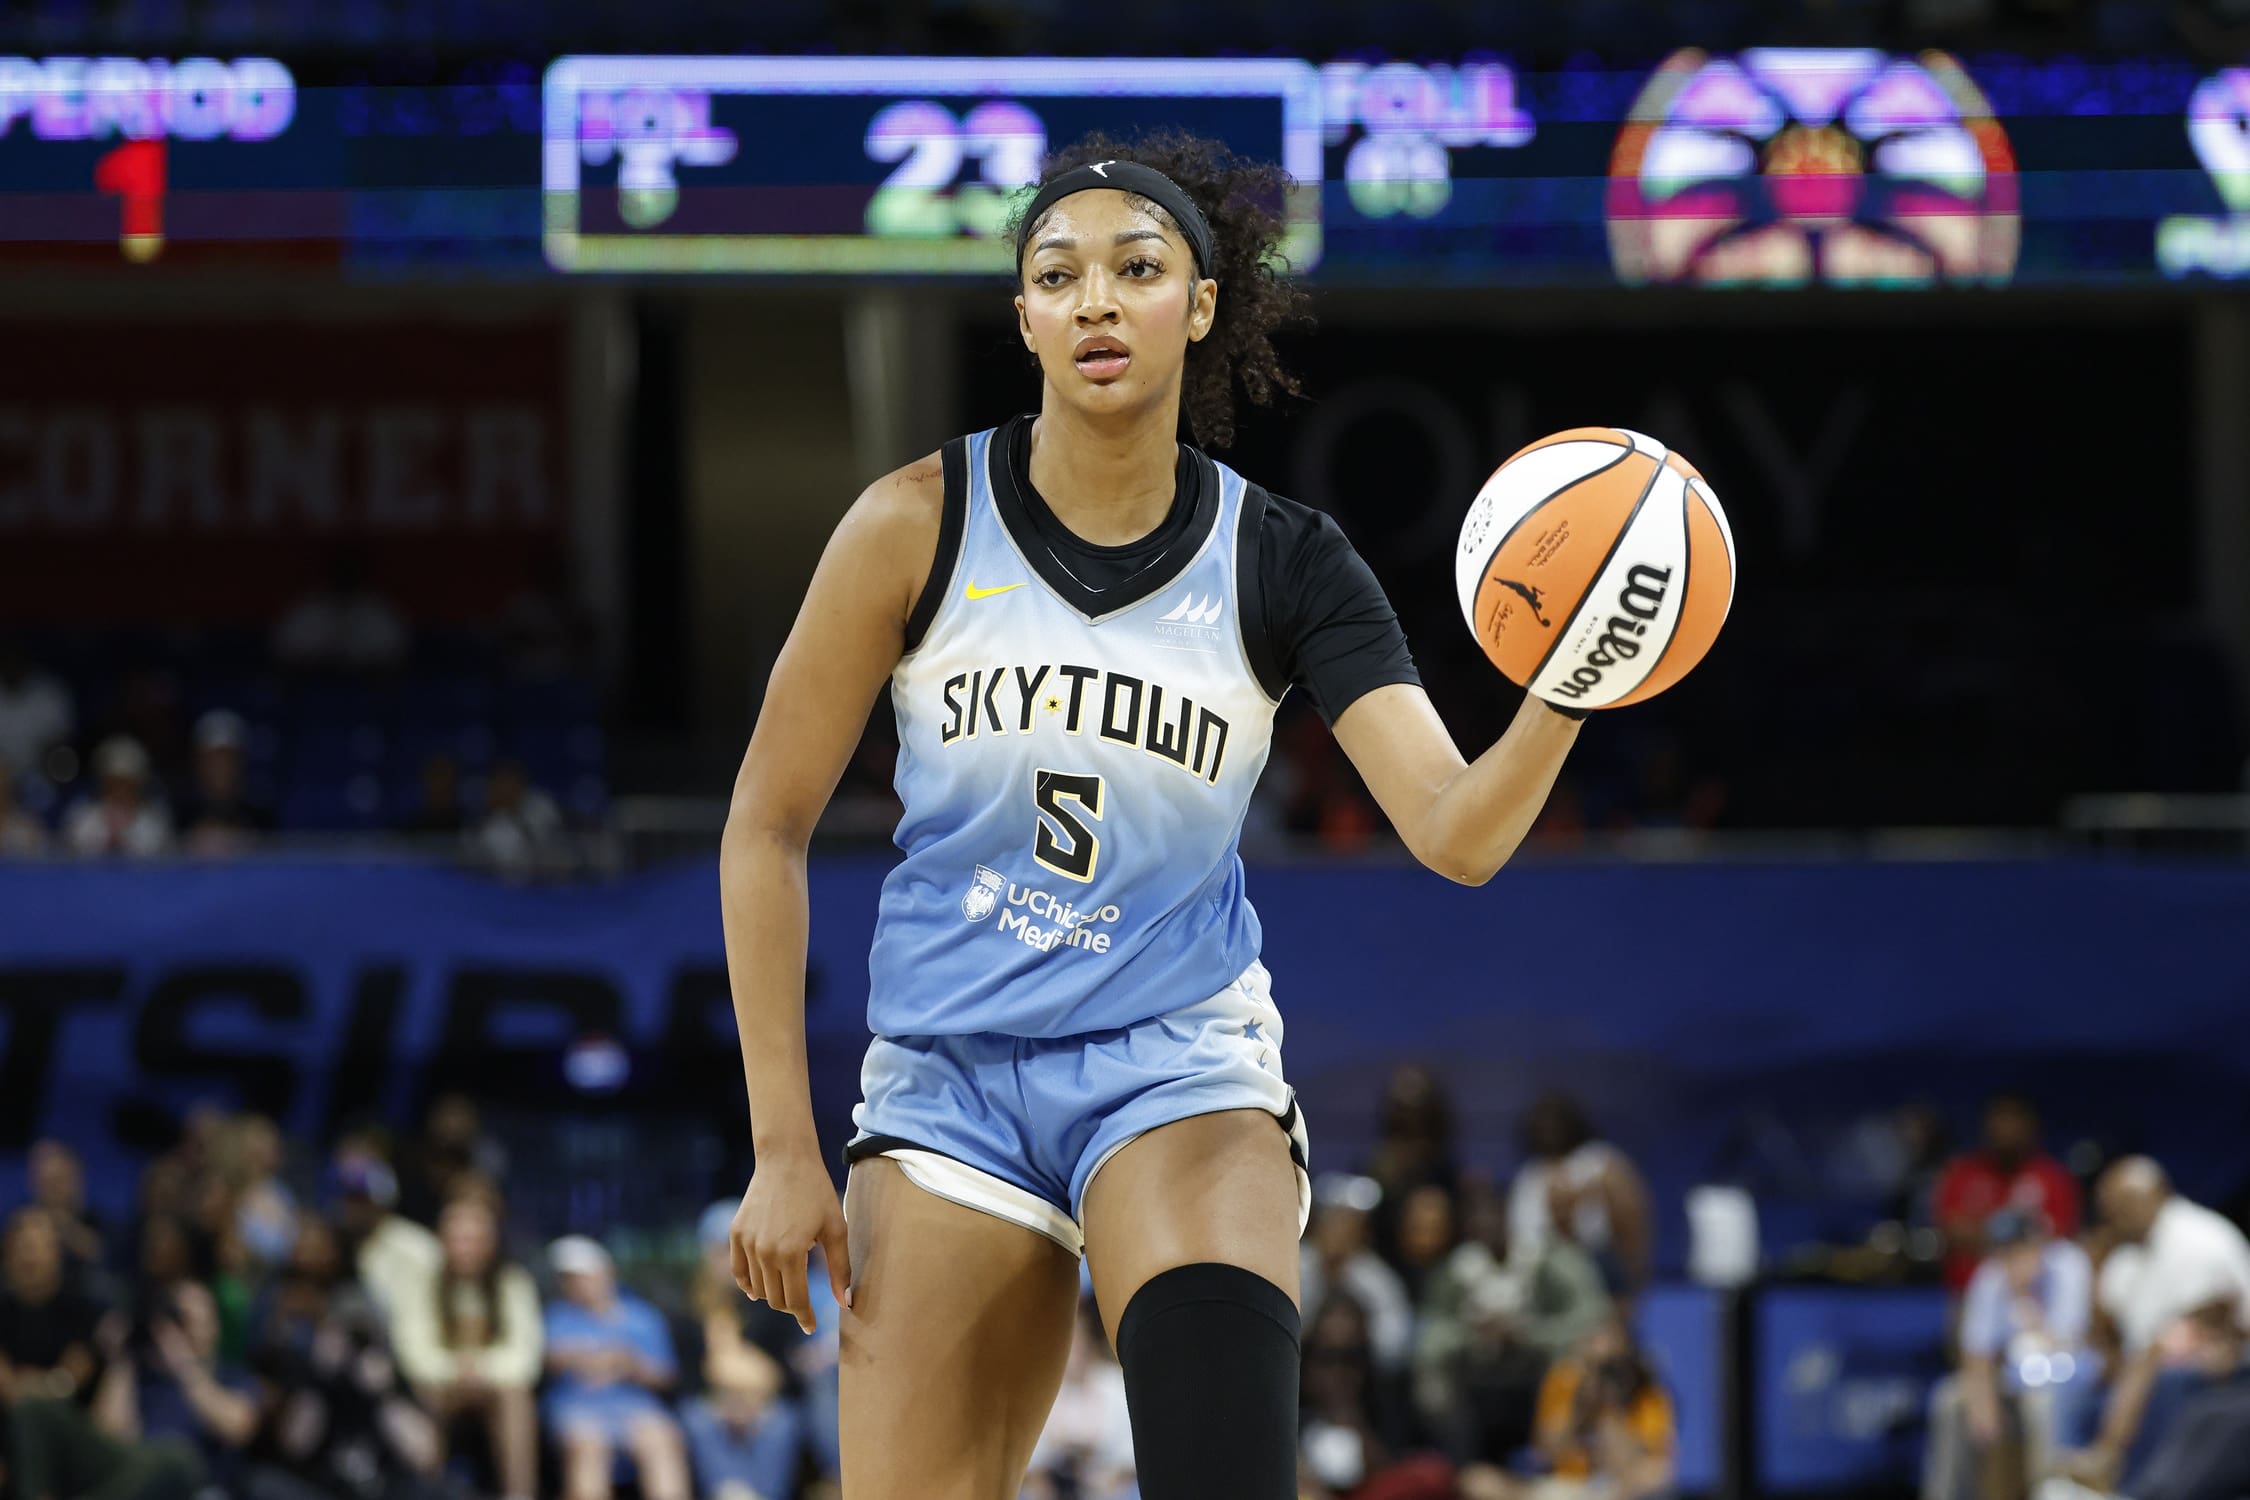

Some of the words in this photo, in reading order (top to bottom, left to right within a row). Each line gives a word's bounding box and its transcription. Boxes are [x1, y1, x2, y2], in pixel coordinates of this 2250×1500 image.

[93, 139, 168, 263] 1
[1536, 530, 1570, 567] OFFICIAL
[1154, 624, 1221, 641] MAGELLAN
[1552, 563, 1672, 699] Wilson
[1033, 767, 1106, 884] 5
[1007, 883, 1120, 929] UChico
[997, 907, 1111, 954] Mediine
